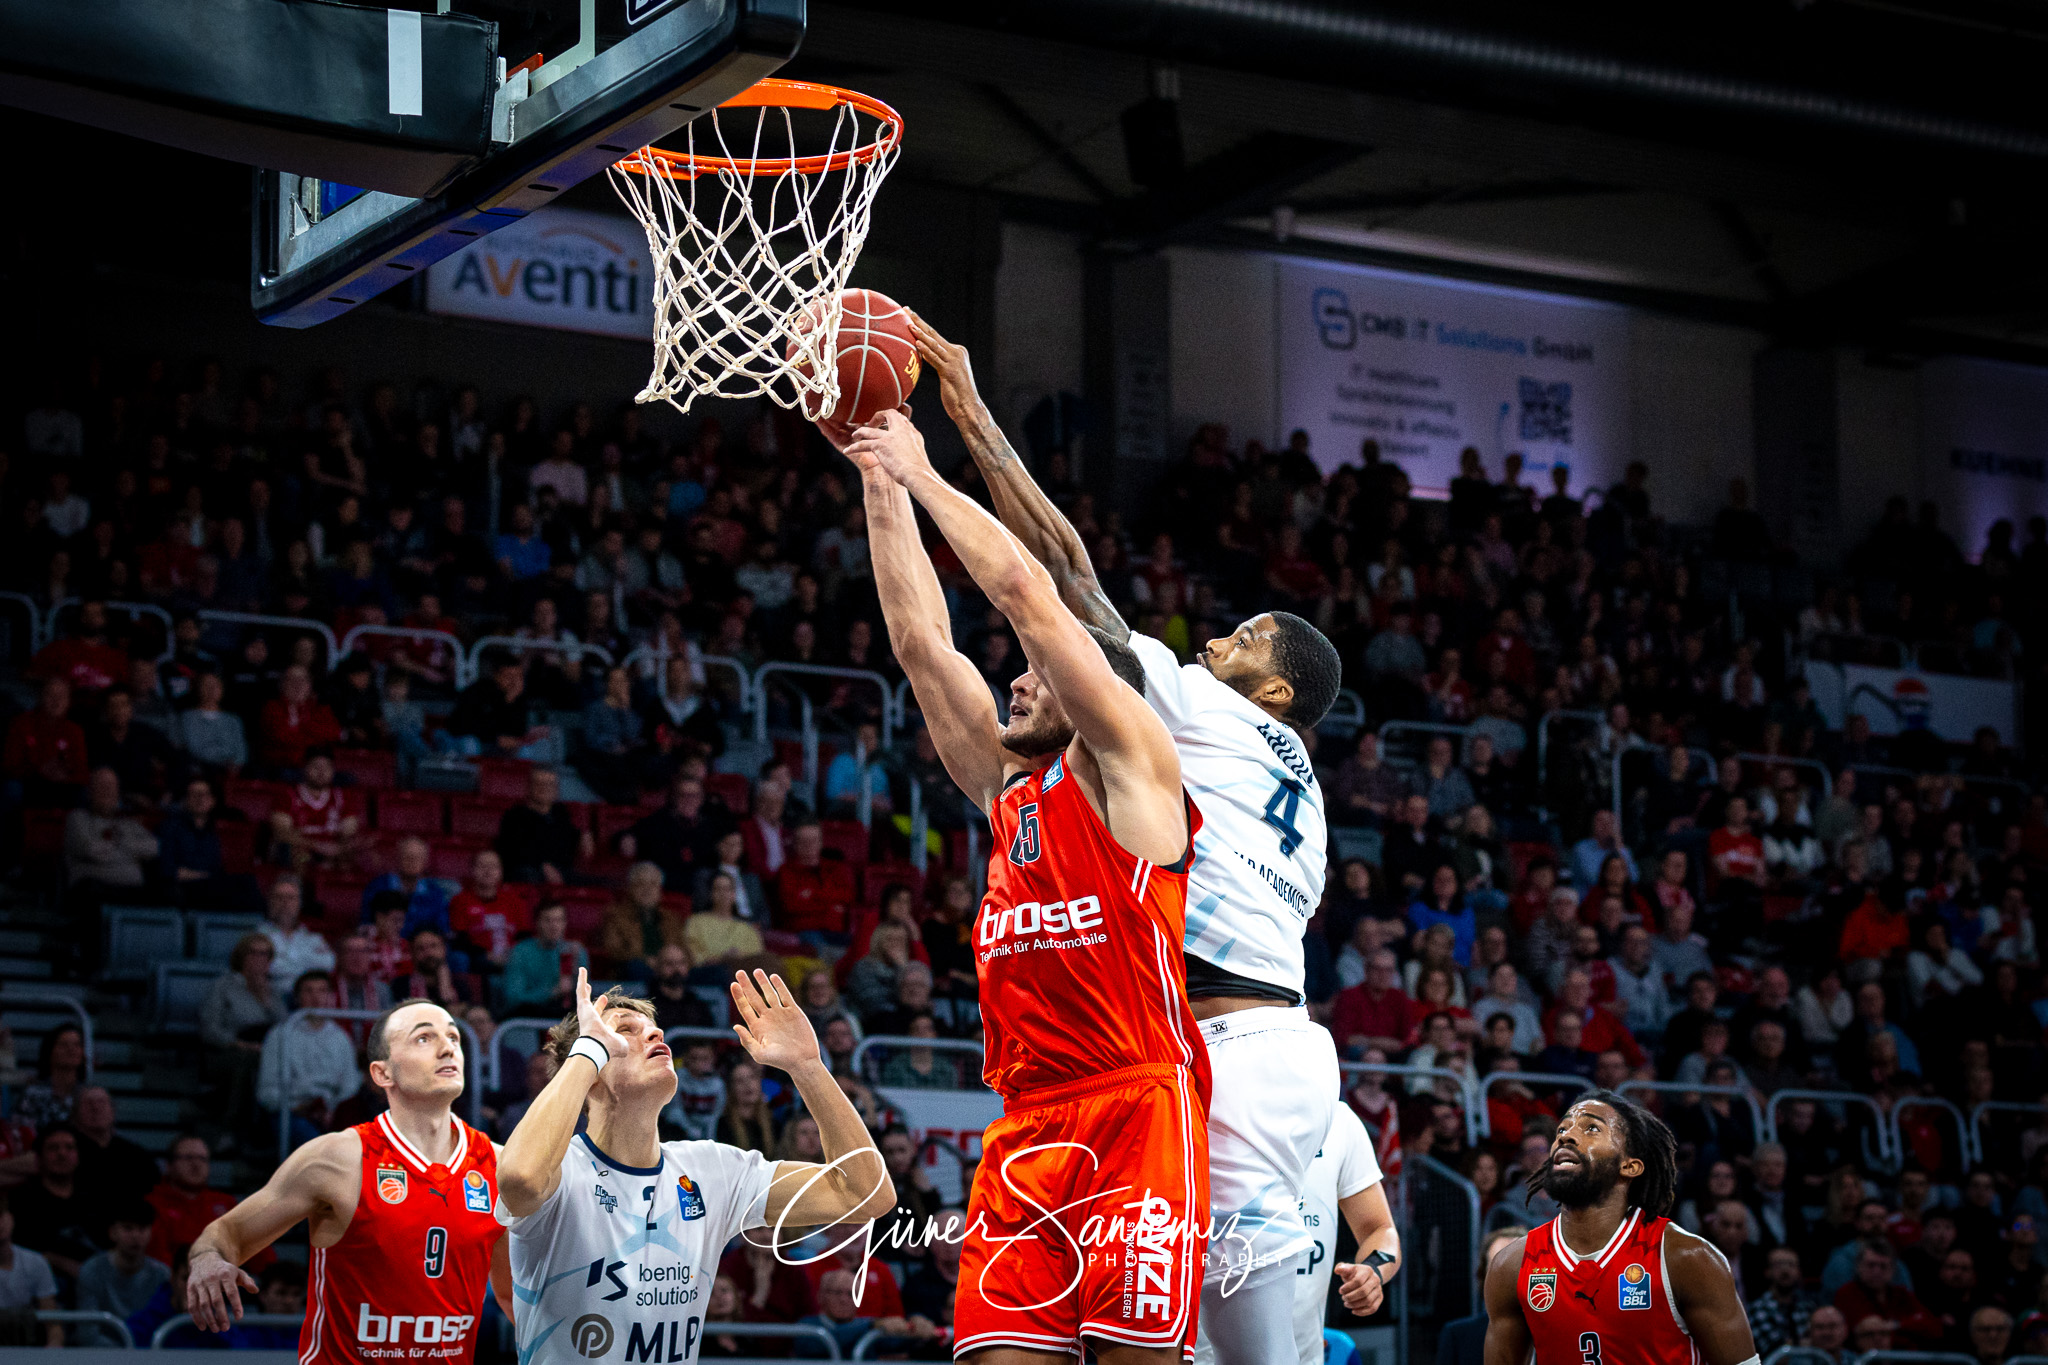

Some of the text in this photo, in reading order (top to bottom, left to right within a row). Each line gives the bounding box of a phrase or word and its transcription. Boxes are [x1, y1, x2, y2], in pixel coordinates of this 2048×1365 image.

[452, 252, 638, 313] Aventi
[1262, 777, 1307, 861] 4
[979, 895, 1104, 946] brose
[1013, 941, 1030, 954] für
[1032, 932, 1108, 951] Automobile
[424, 1226, 448, 1278] 9
[1122, 1270, 1134, 1319] KOLLEGEN
[1623, 1296, 1647, 1306] BBL
[357, 1303, 475, 1343] brose
[624, 1316, 700, 1364] MLP
[357, 1346, 405, 1359] Technik
[408, 1346, 427, 1358] für
